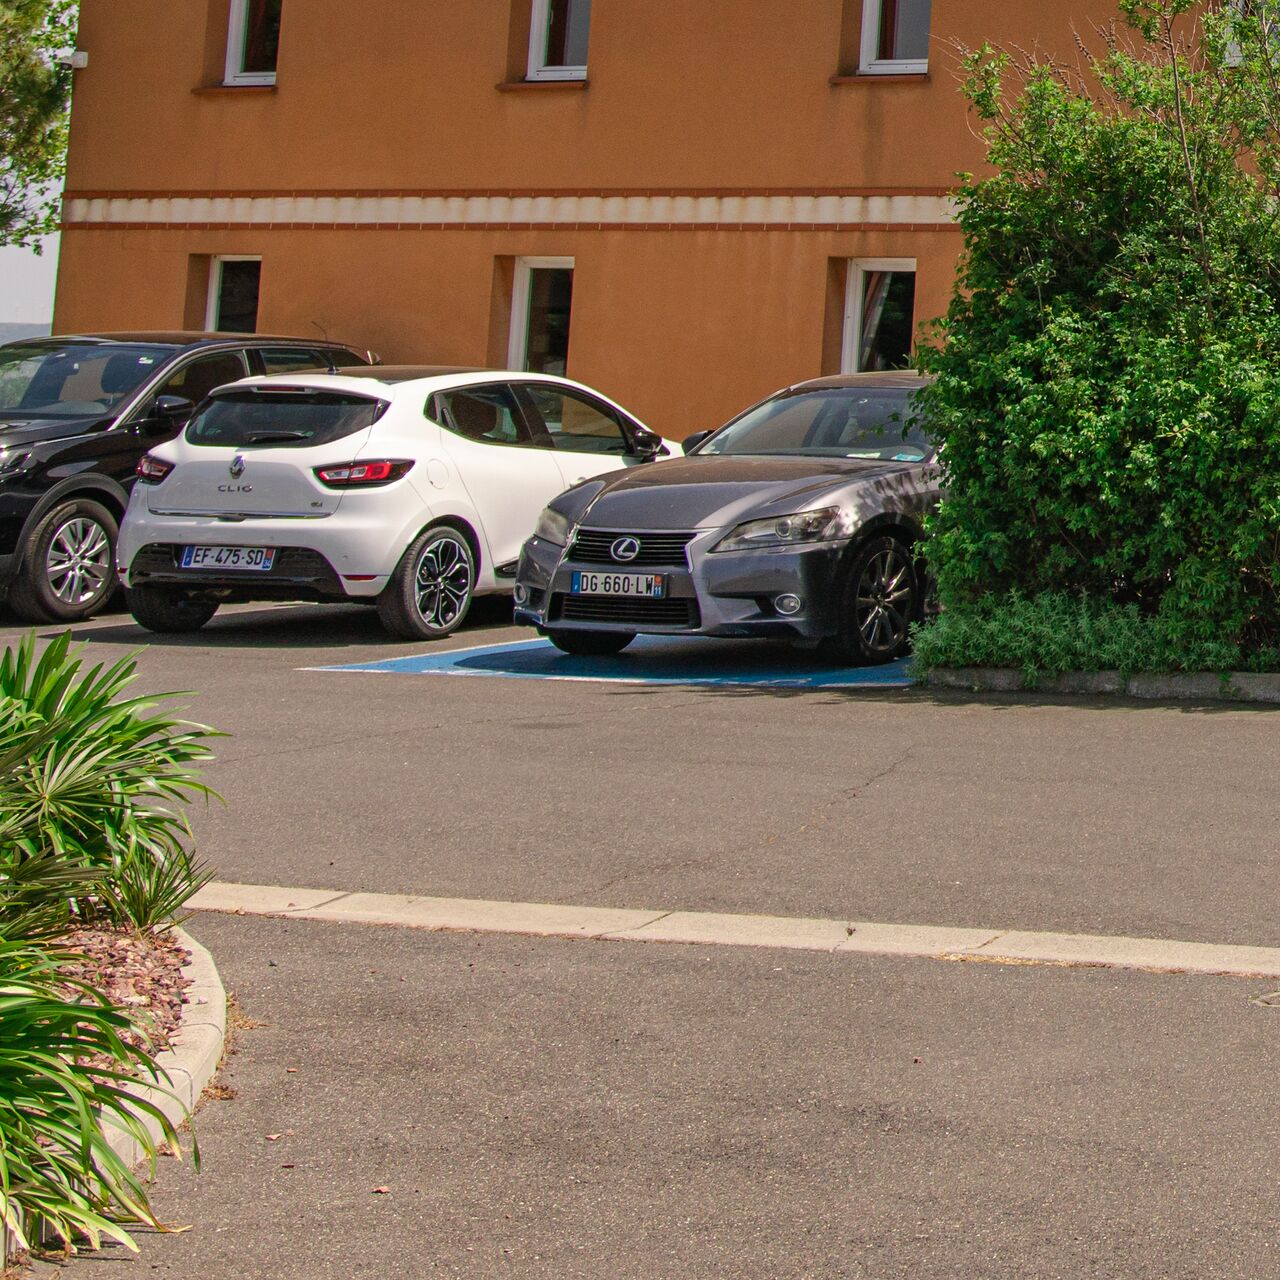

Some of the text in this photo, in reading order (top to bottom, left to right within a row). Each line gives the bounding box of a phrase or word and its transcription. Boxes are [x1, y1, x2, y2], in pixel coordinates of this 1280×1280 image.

[217, 484, 253, 493] CLIO
[193, 547, 264, 566] EF-475-SD
[581, 574, 654, 595] DG-660-LW
